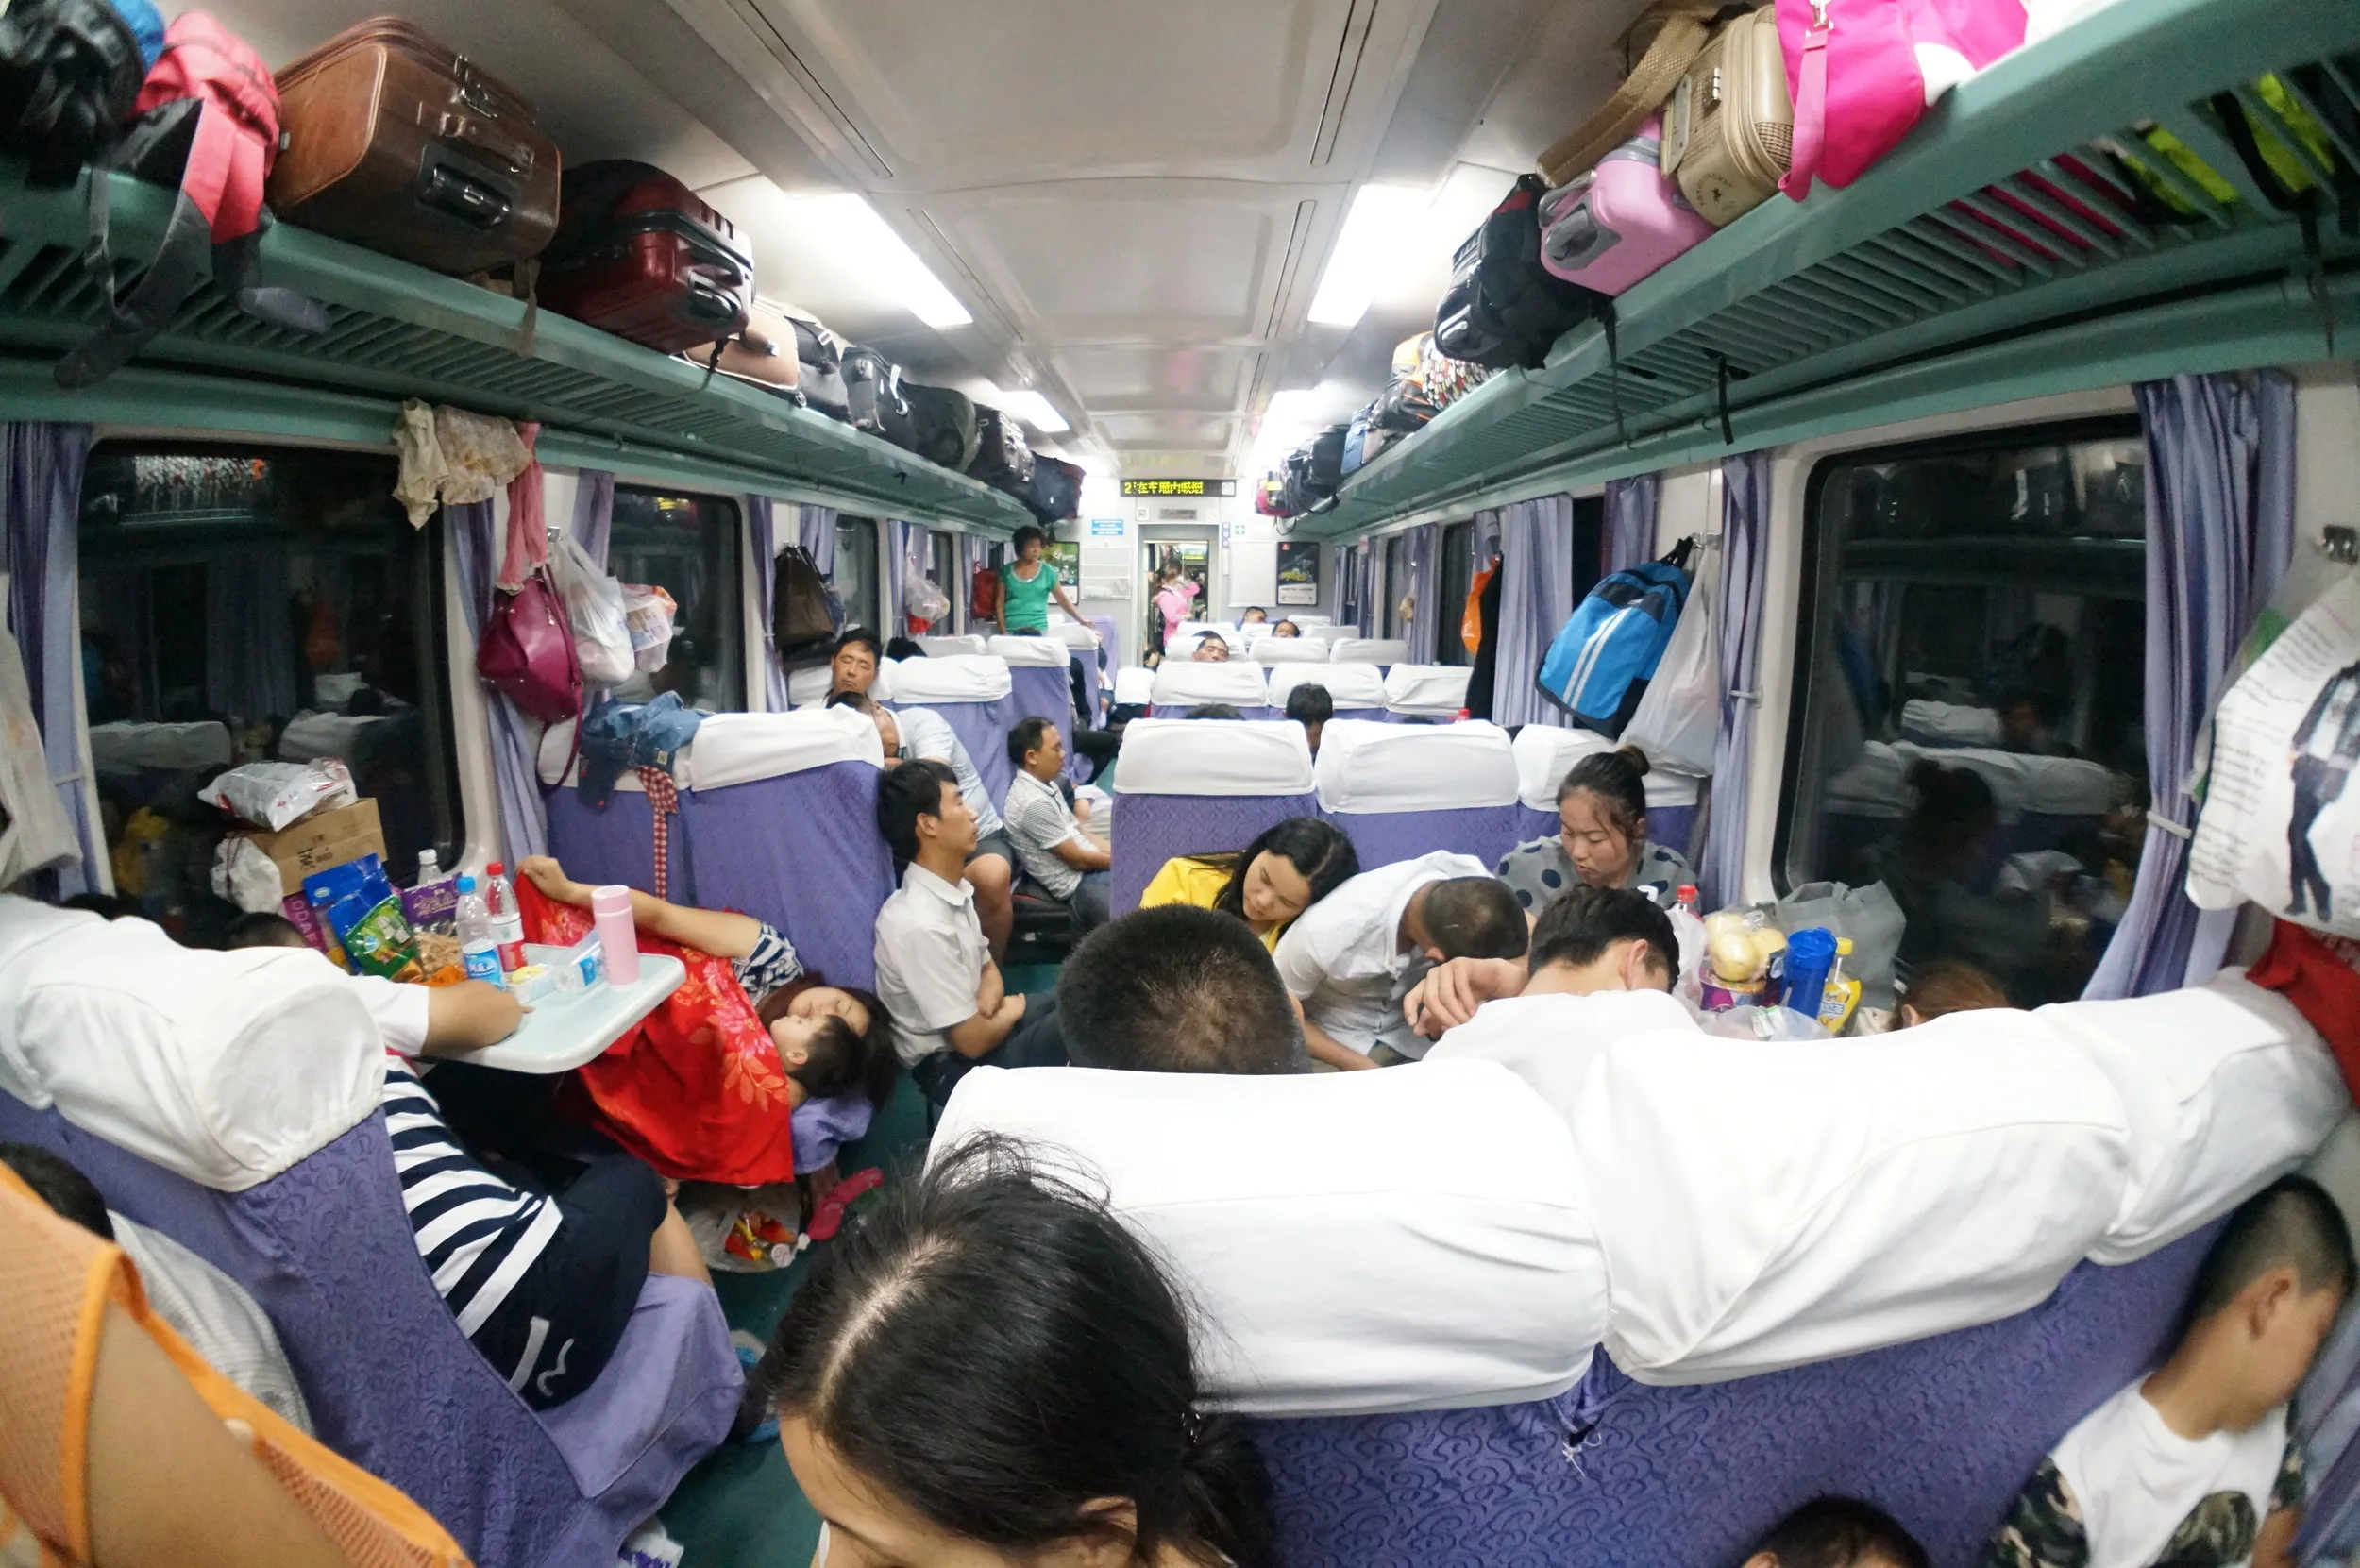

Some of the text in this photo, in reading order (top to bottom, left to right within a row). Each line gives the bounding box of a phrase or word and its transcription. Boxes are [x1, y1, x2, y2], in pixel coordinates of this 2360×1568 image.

[1124, 481, 1204, 495] 2 在车厢内吸烟
